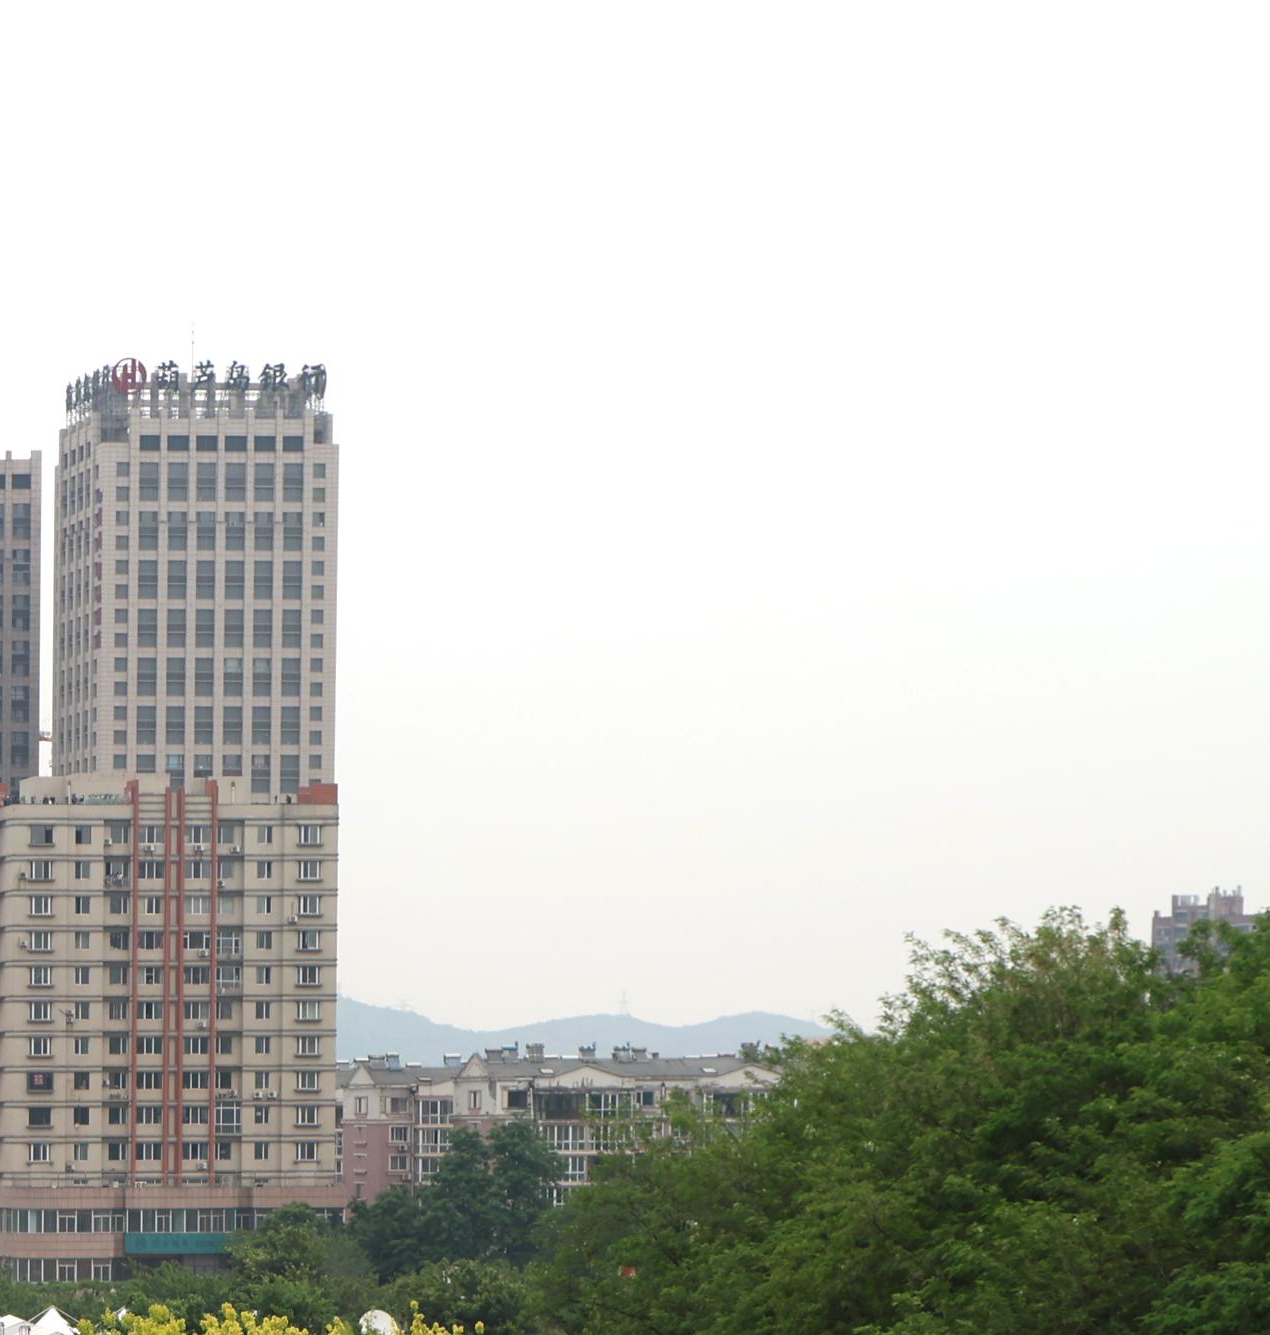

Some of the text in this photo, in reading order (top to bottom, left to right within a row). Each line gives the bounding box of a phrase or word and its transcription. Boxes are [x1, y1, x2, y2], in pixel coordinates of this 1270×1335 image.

[156, 360, 327, 400] 葫芦岛银行
